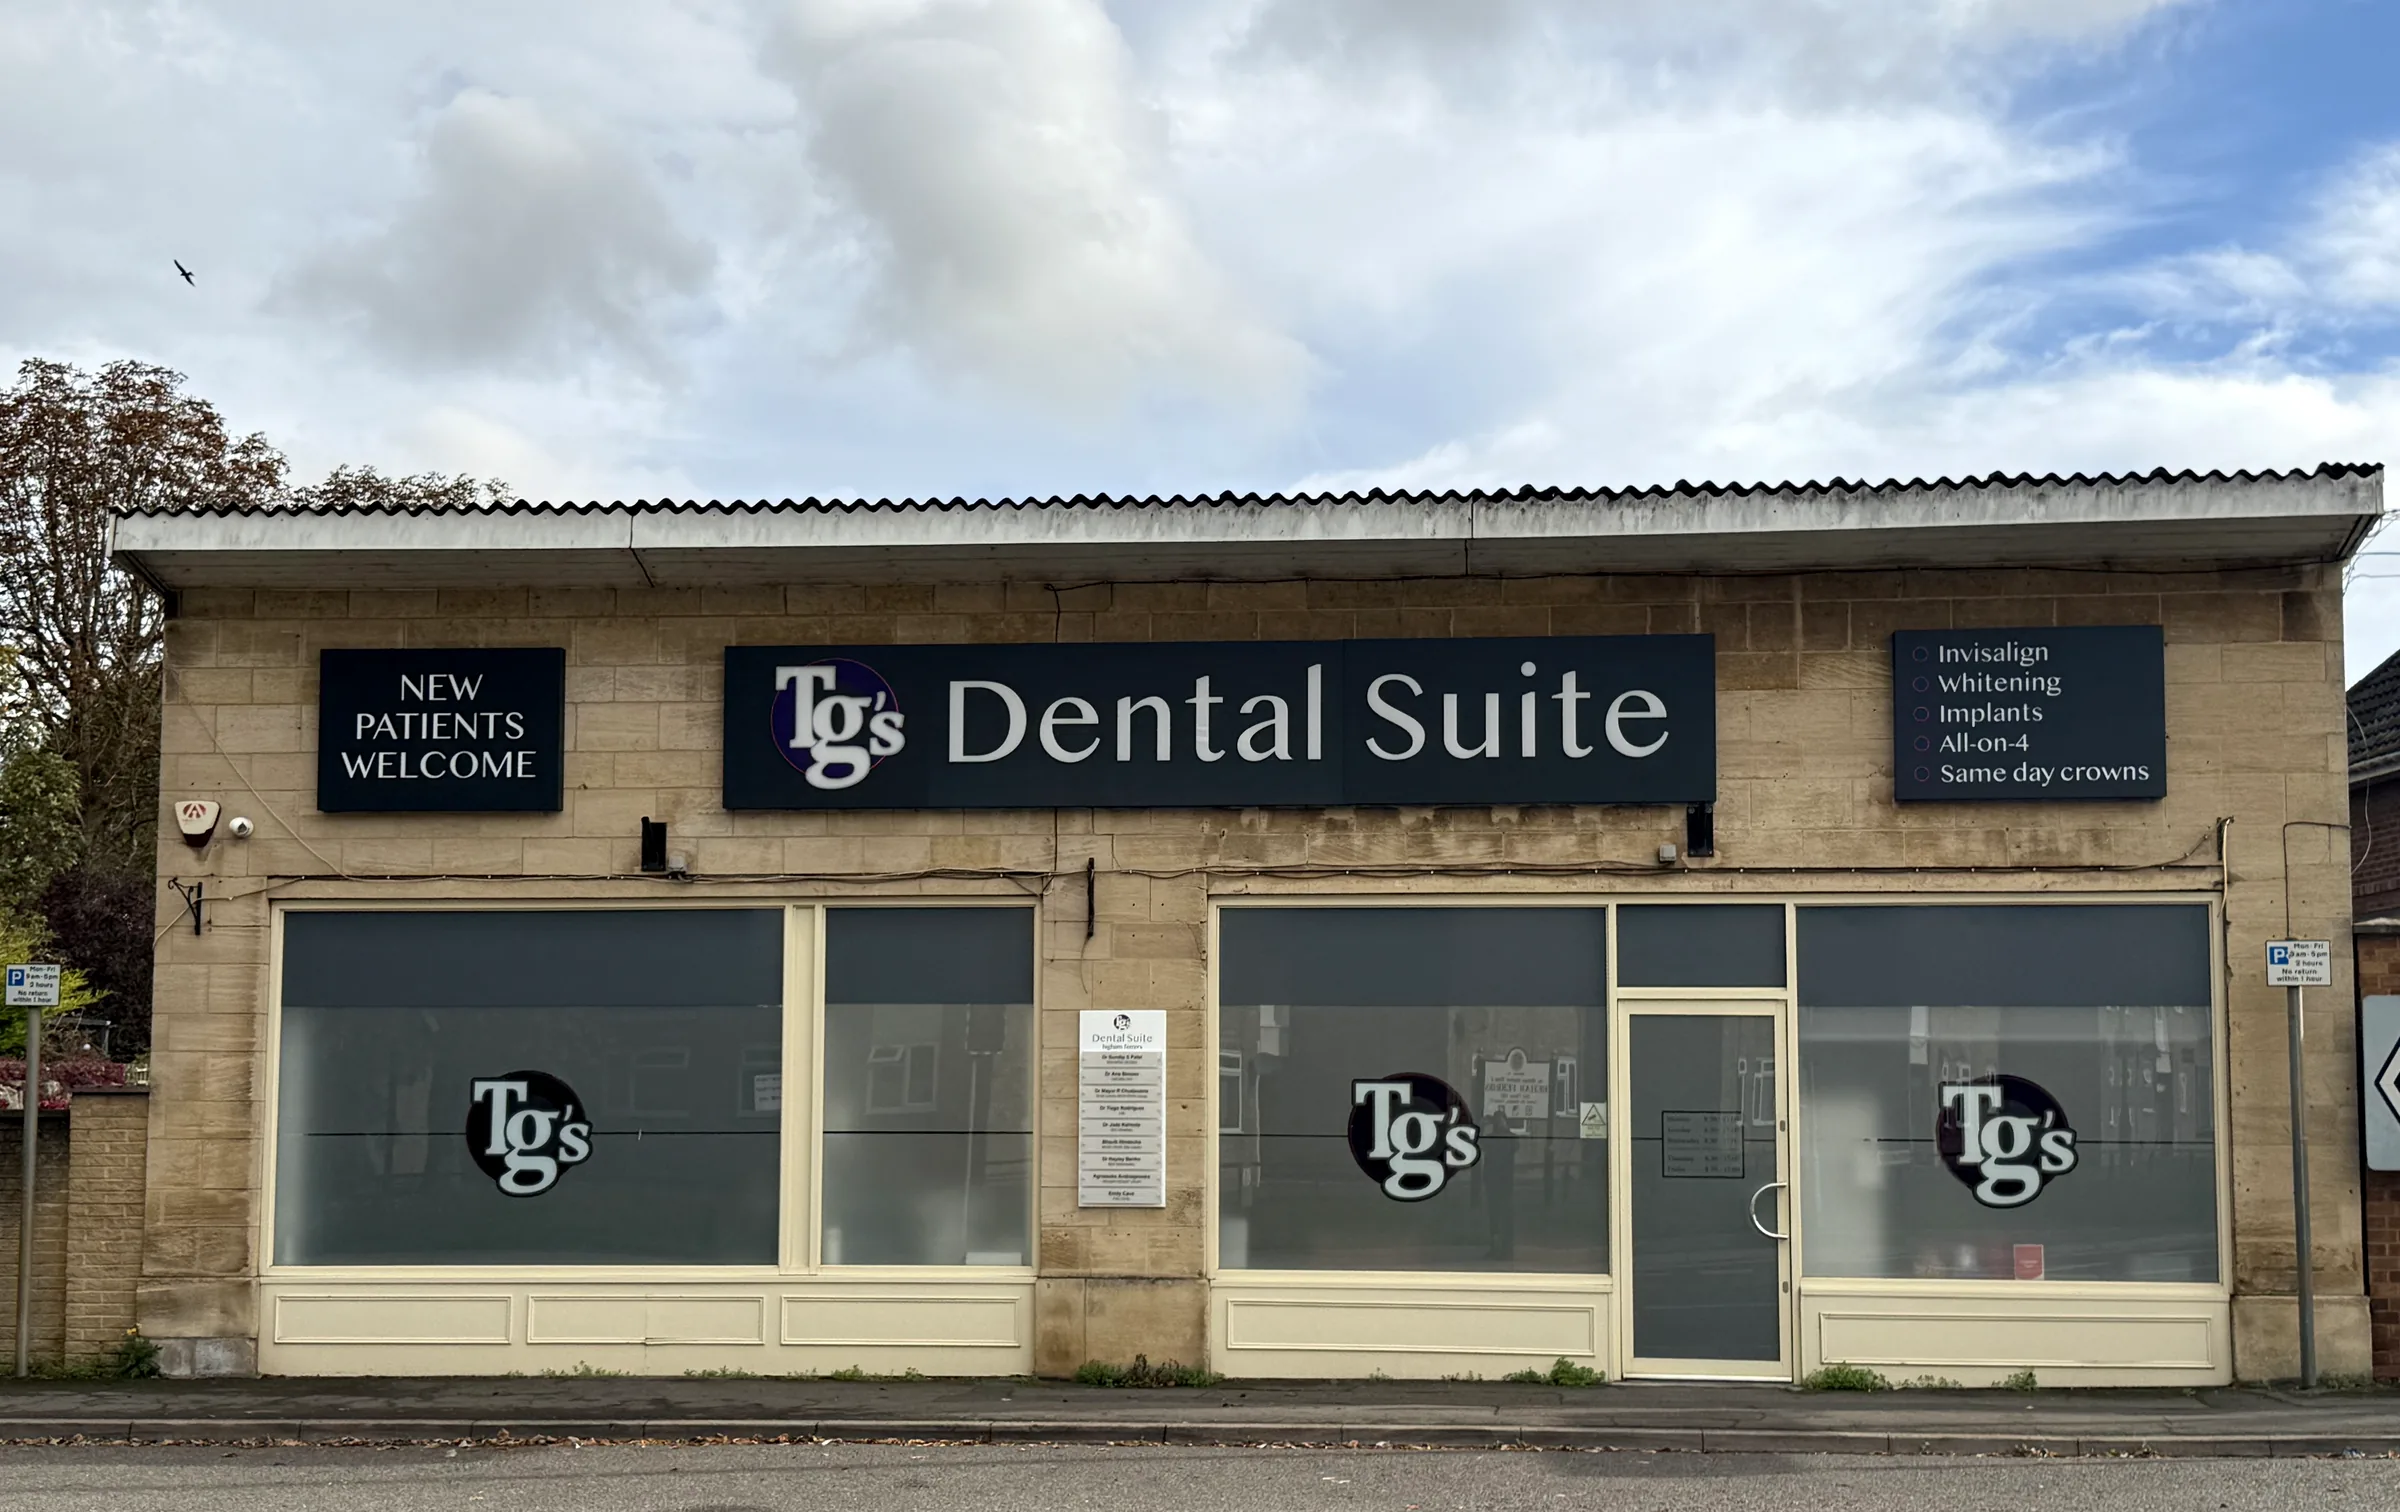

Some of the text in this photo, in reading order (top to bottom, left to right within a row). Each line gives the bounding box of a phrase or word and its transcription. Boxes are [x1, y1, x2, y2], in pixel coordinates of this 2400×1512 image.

[1939, 641, 2049, 667] Invisalign
[400, 673, 484, 702] NEW
[1937, 671, 2062, 696] Whitening
[948, 663, 1323, 764] Dental
[1364, 660, 1670, 761] Suite
[1940, 702, 2043, 727] Implants
[356, 711, 525, 740] PATIENTS
[1939, 732, 2030, 753] All-on-4
[341, 750, 537, 779] WELCOME
[1940, 761, 2150, 788] Same day crowns
[1092, 1033, 1153, 1043] Dental Suite
